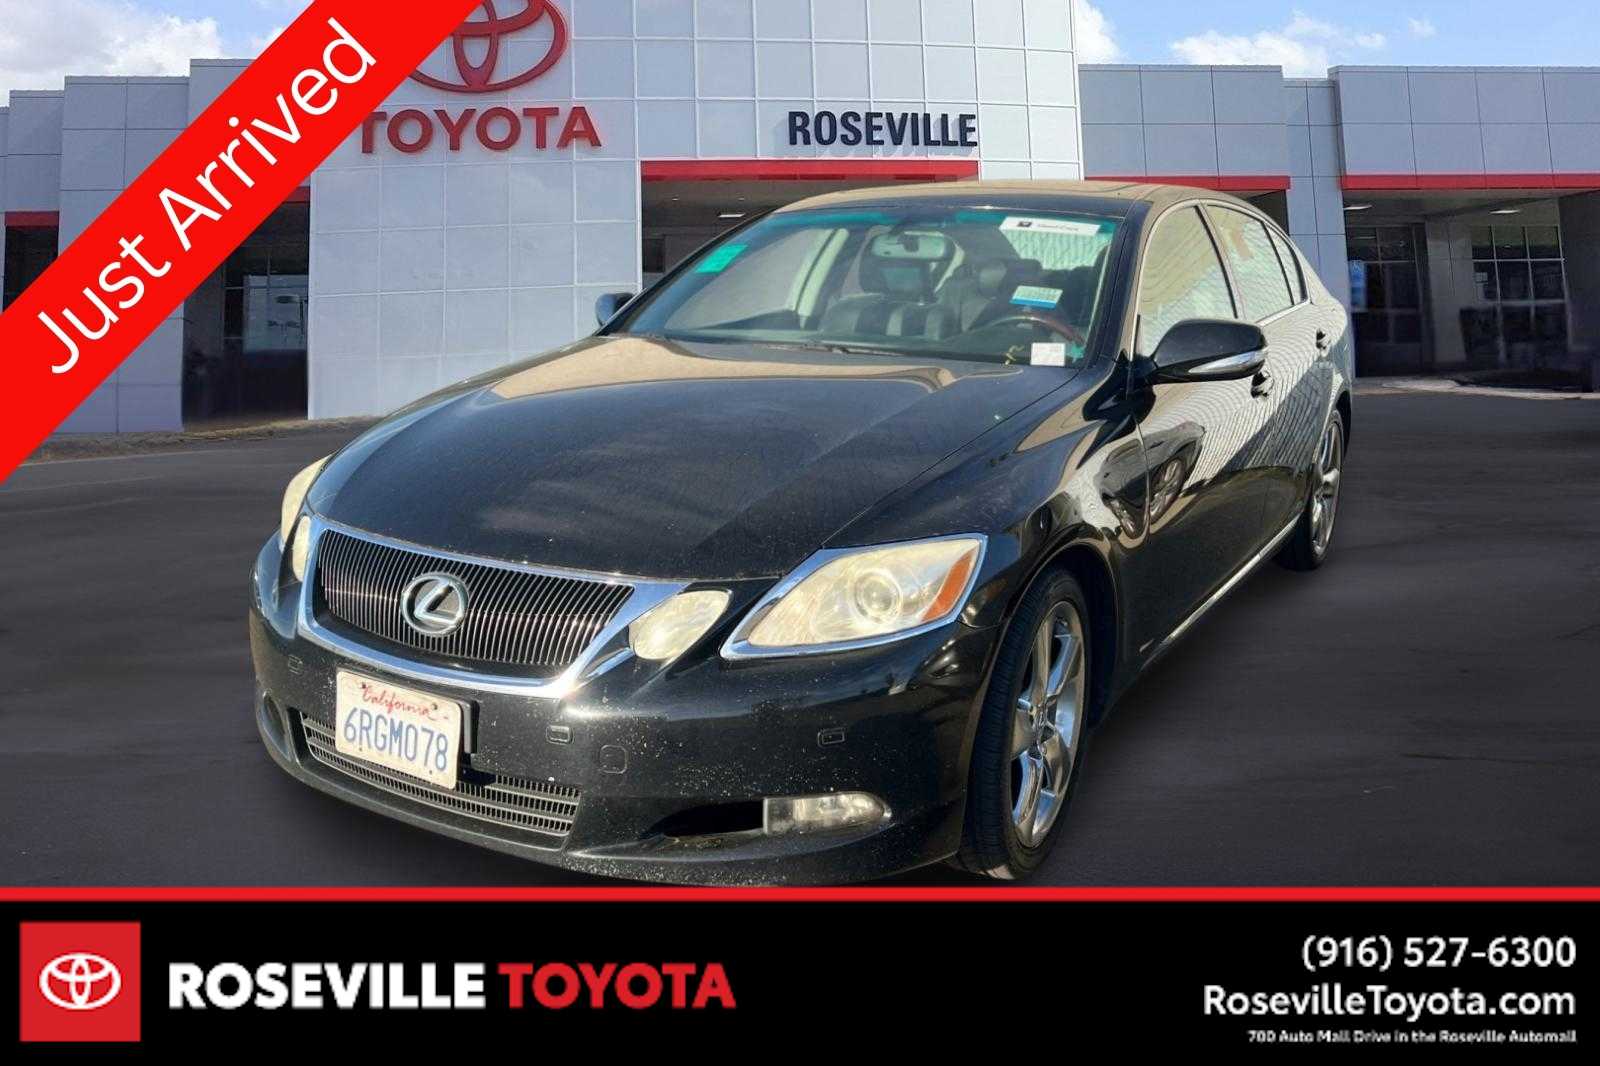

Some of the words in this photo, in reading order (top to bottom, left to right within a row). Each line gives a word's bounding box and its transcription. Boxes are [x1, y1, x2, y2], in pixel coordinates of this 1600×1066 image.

[361, 106, 602, 154] TOYOTA
[788, 110, 978, 147] ROSEVILLE
[361, 683, 437, 721] California
[343, 706, 449, 772] 6RGM078
